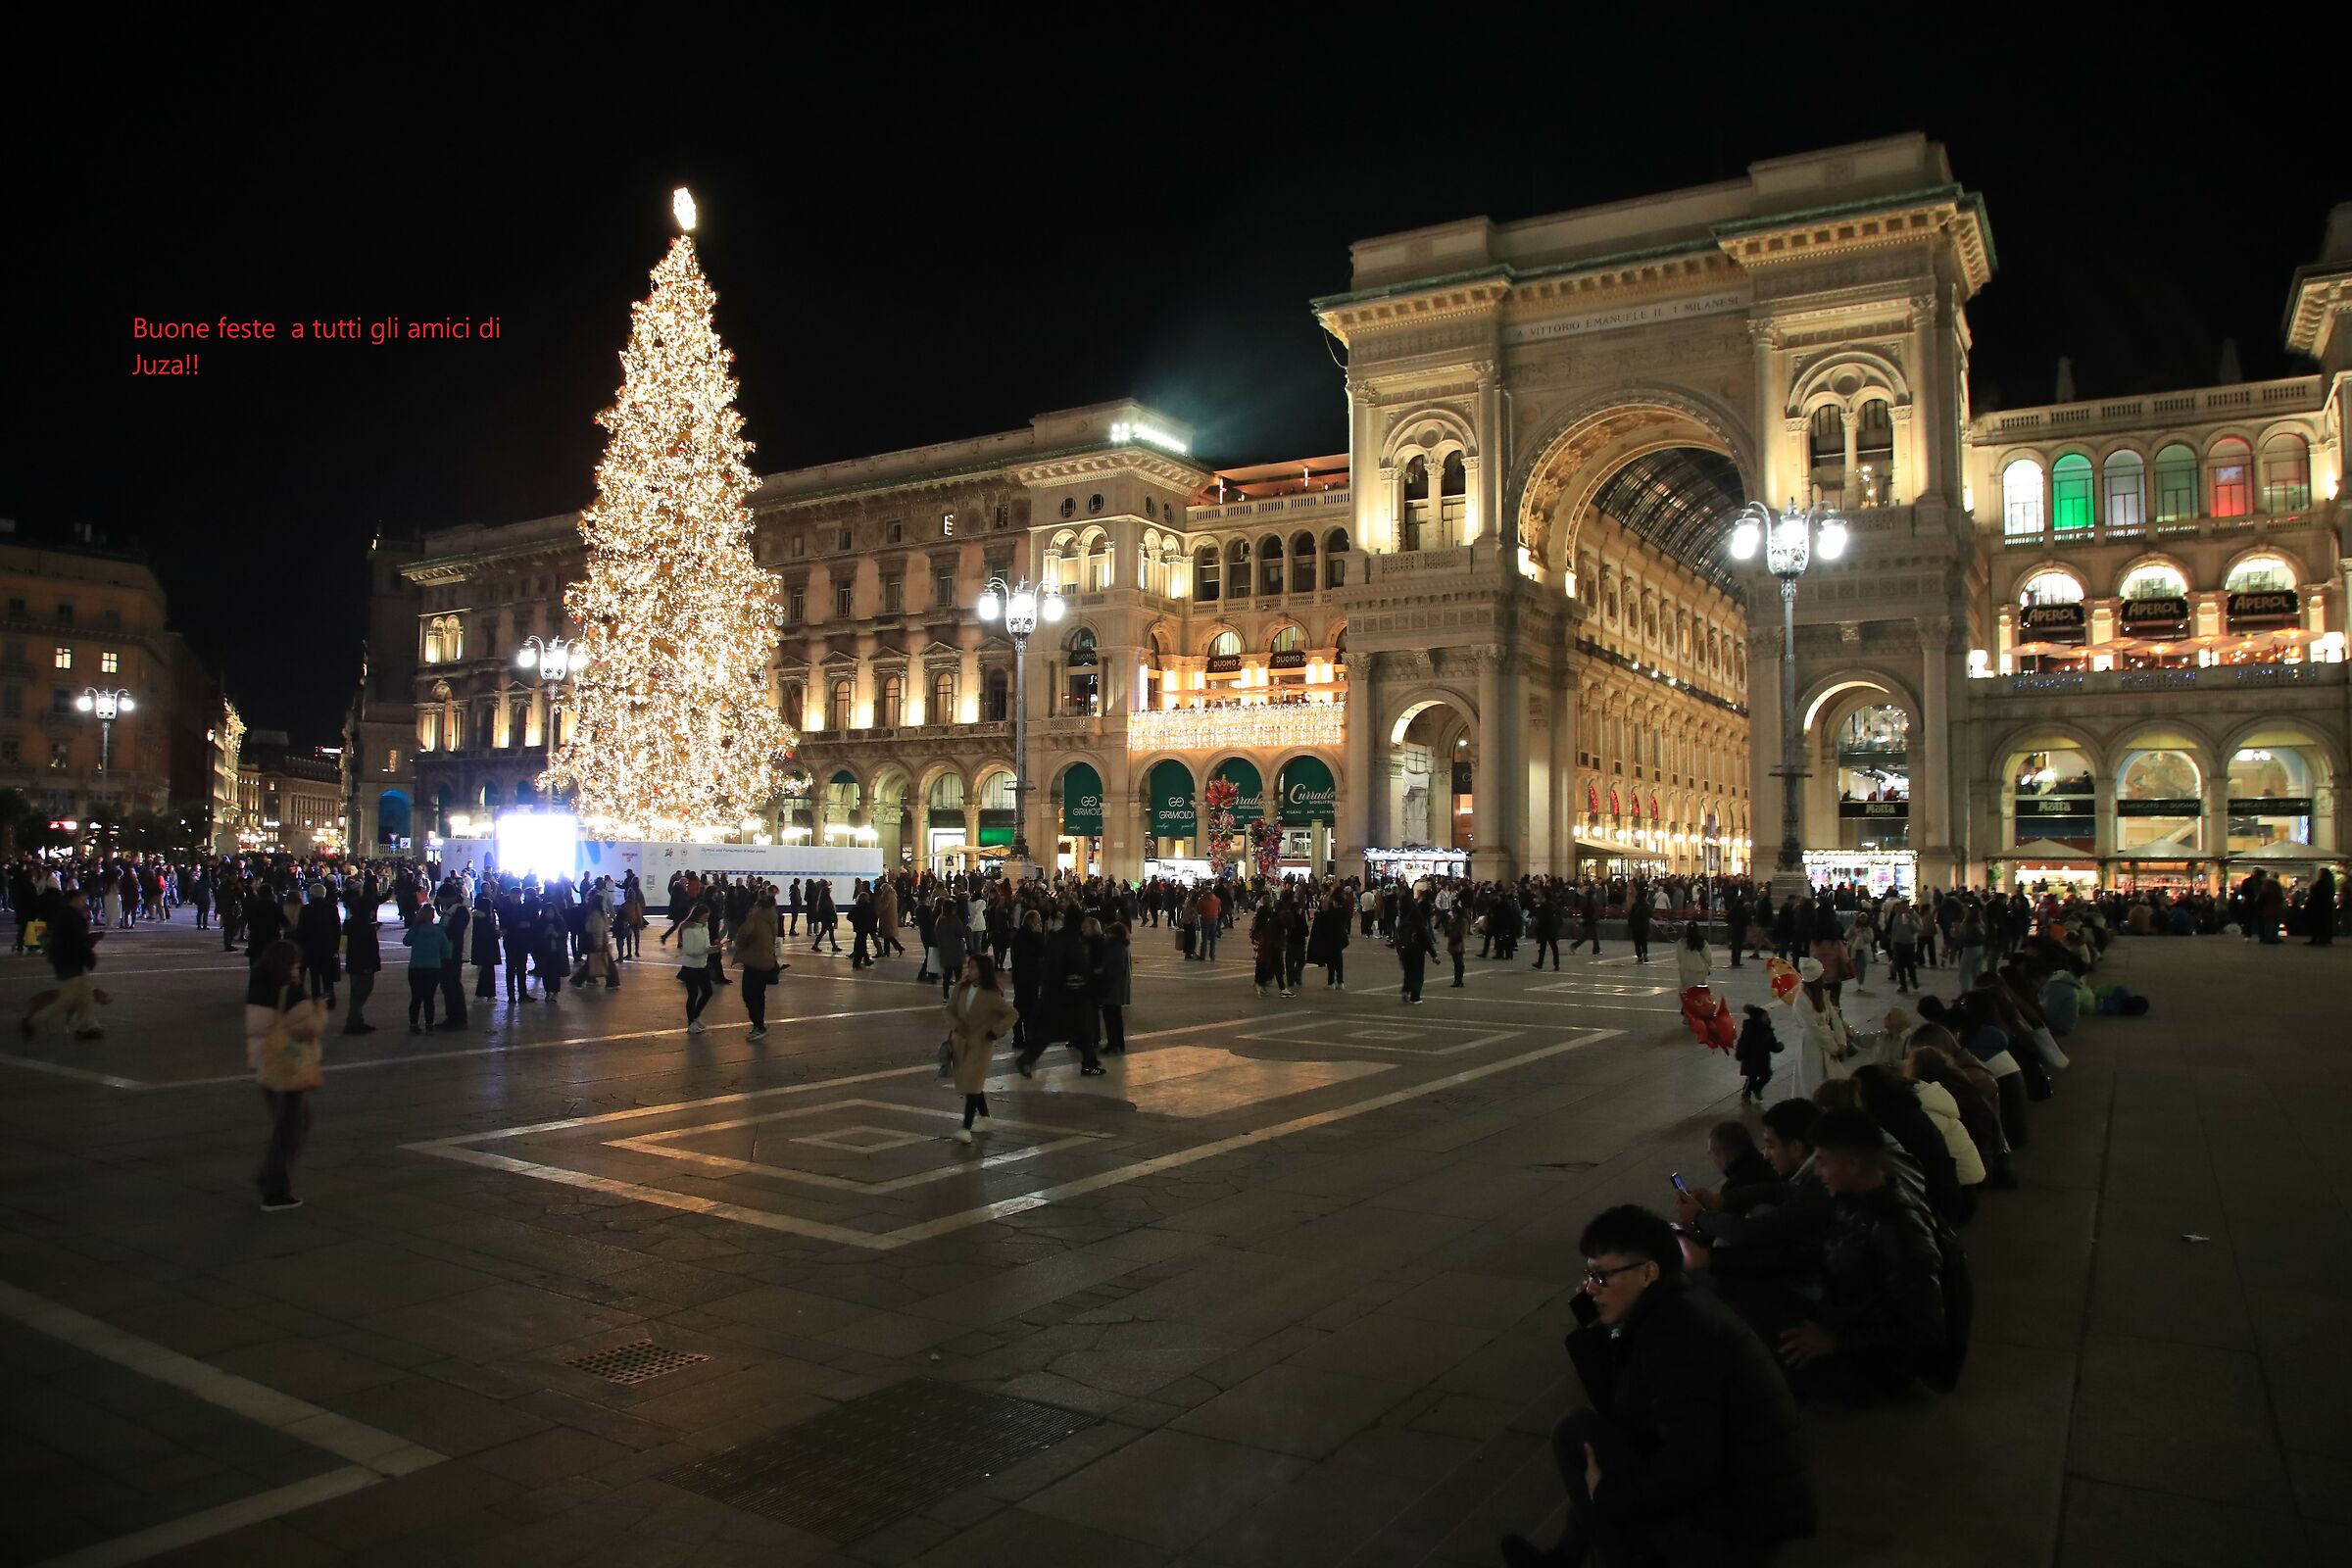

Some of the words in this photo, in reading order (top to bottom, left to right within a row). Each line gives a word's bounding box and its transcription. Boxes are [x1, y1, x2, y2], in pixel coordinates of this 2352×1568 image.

[1530, 321, 1580, 337] VITTORIO
[1587, 311, 1647, 328] EMANUELE
[1684, 296, 1740, 313] MILANESI
[2128, 601, 2180, 617] APEROL
[2234, 594, 2290, 612] APEROL
[2028, 608, 2078, 624] APEROL
[1213, 659, 1237, 667] DUOMO
[1866, 804, 1895, 813] Motta
[2038, 801, 2072, 812] Motta
[1158, 810, 1195, 819] GRIMOLDI
